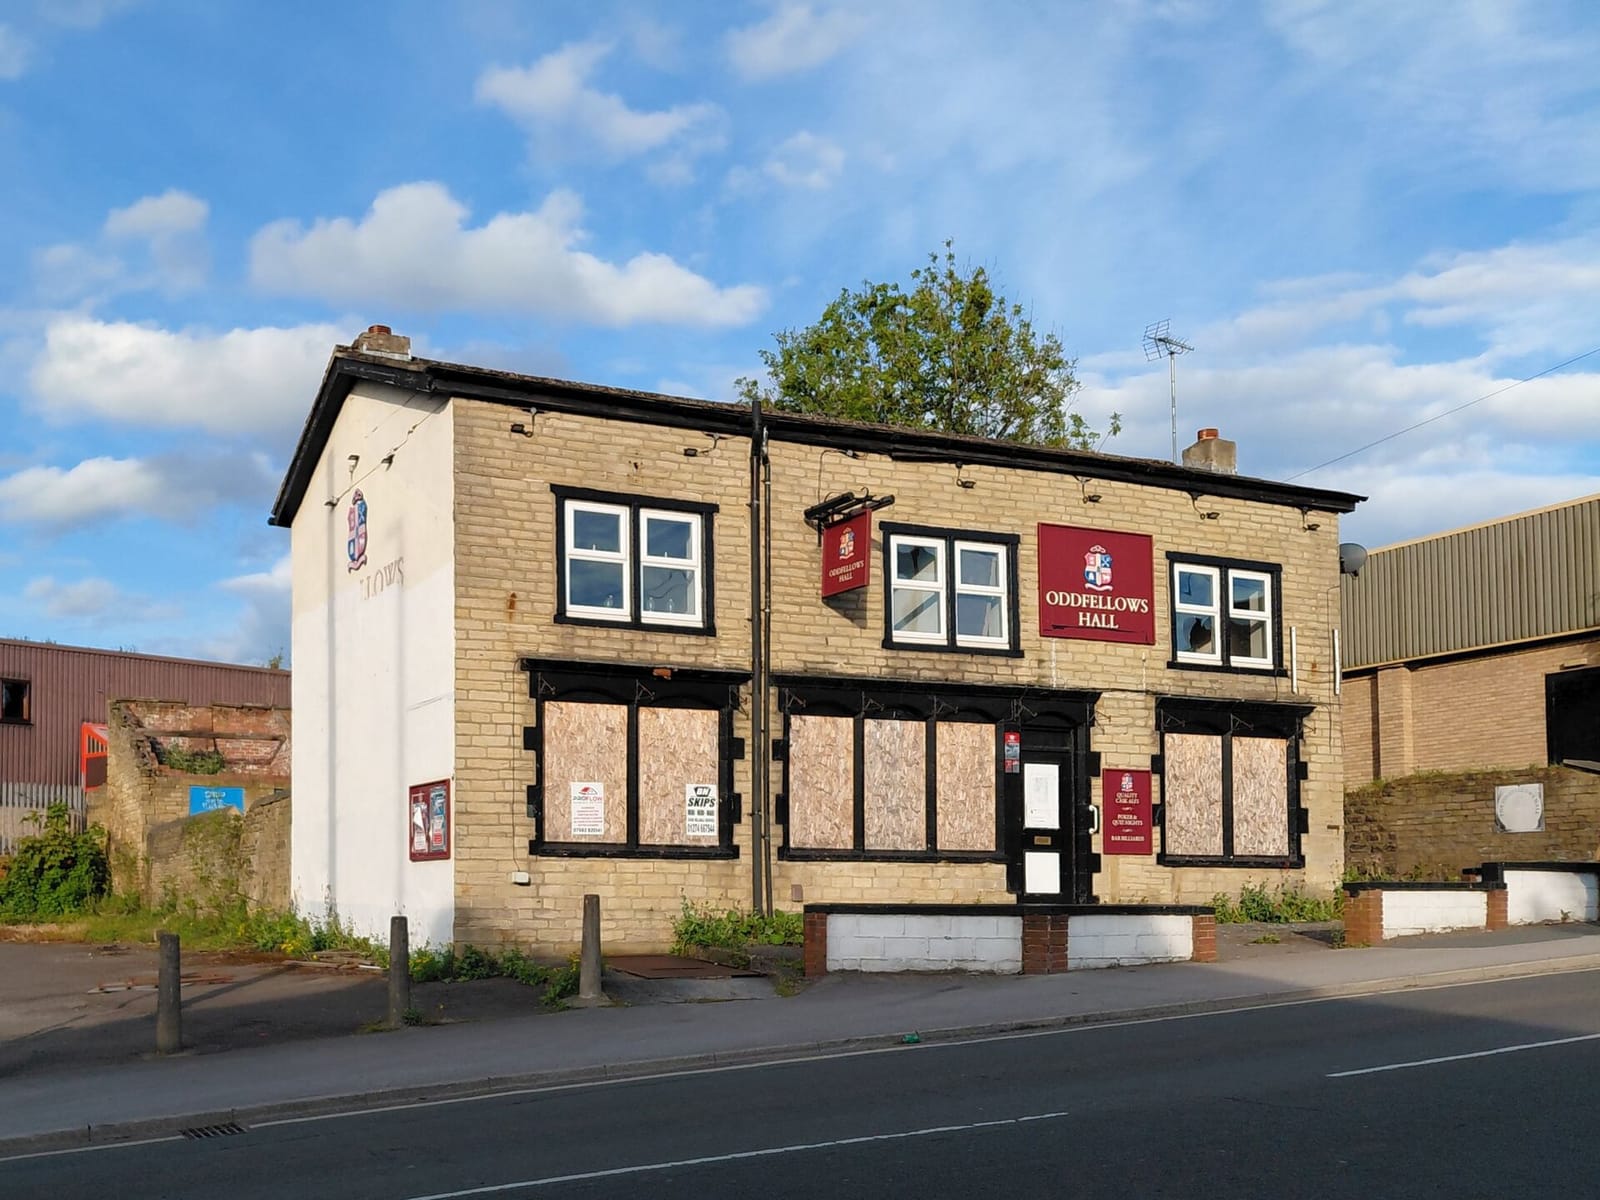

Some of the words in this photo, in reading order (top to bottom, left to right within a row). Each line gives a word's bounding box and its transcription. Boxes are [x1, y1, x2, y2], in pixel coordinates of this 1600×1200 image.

[828, 560, 865, 577] ODDFELLOWS
[838, 572, 853, 583] HALL
[1045, 590, 1149, 614] ODDFELLOWS
[1078, 611, 1119, 629] HALL
[688, 797, 716, 808] SKIPS
